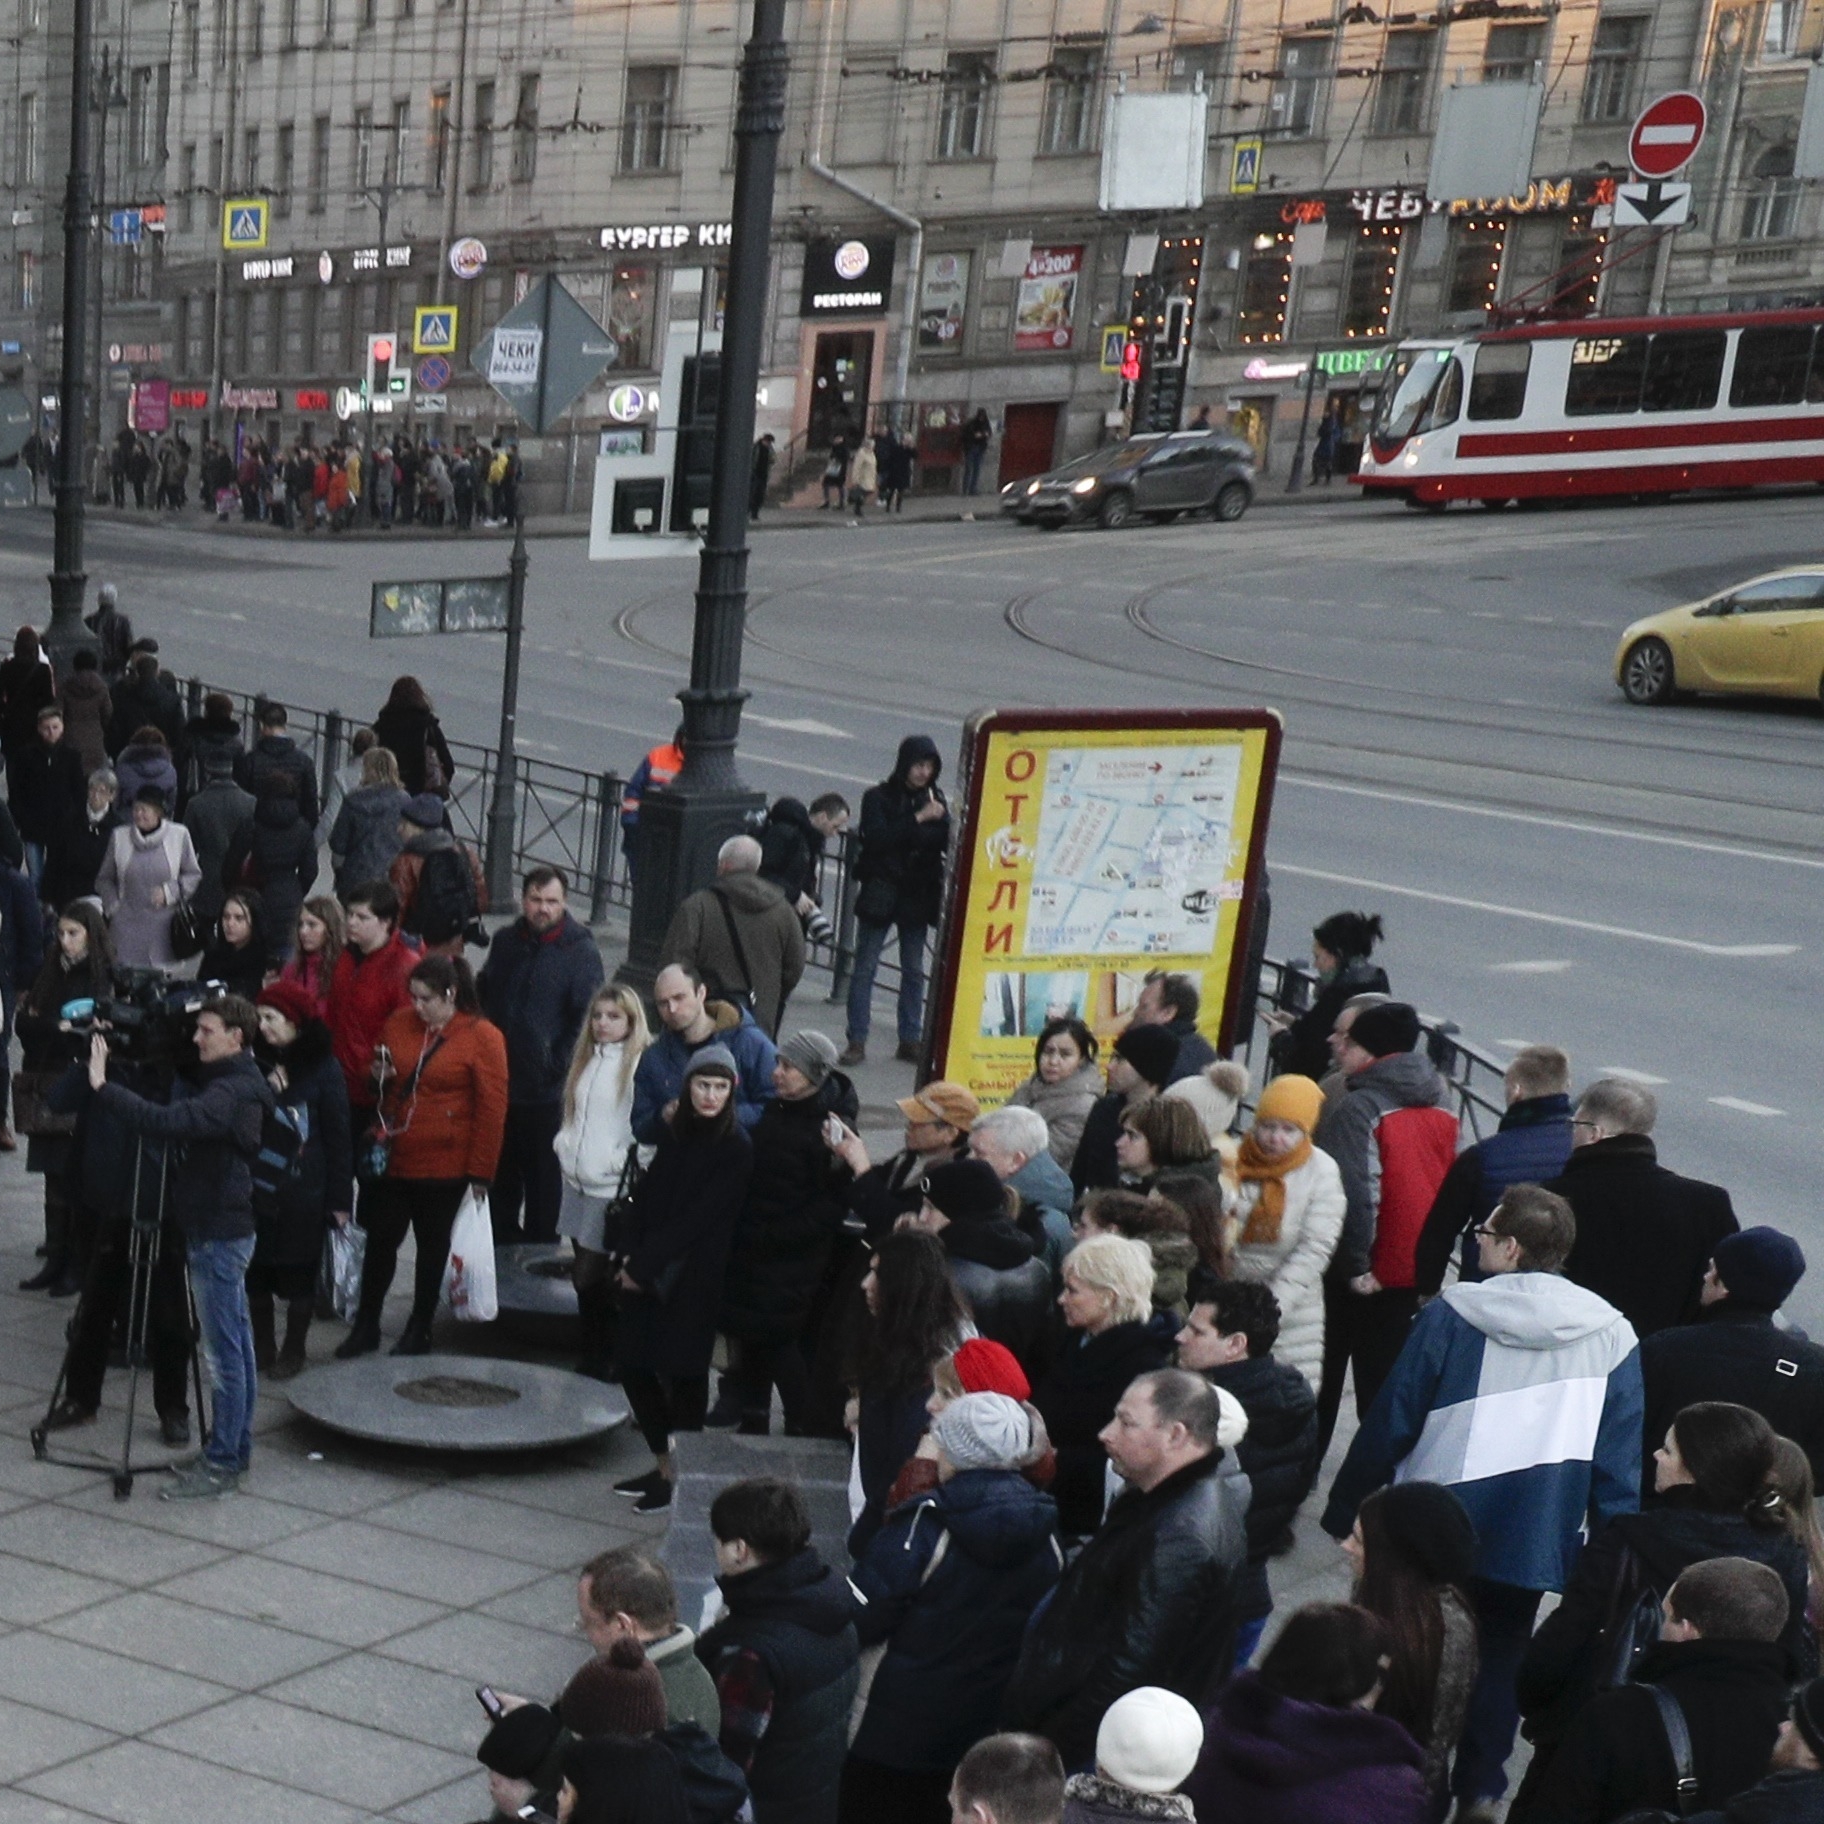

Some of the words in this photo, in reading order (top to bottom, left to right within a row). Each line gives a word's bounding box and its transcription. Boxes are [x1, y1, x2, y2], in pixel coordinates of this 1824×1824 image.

[600, 225, 690, 250] БУРГЕР
[813, 292, 883, 308] РЕСТОРАН
[499, 341, 536, 359] ЧЕКИ
